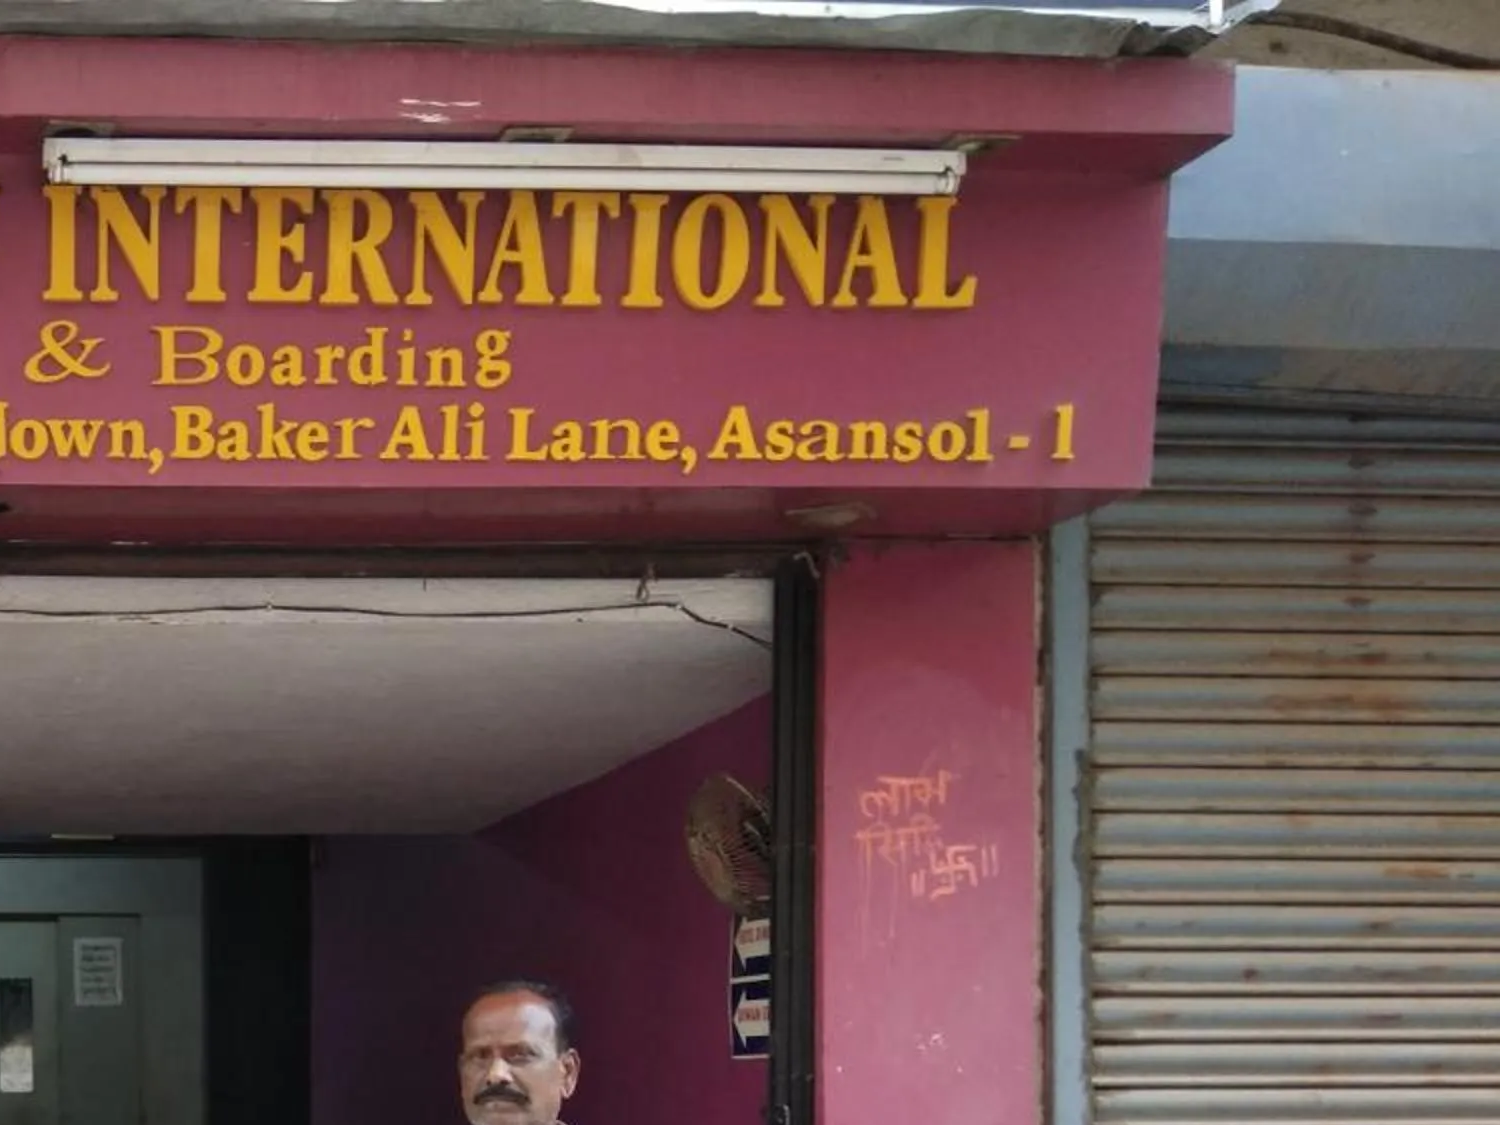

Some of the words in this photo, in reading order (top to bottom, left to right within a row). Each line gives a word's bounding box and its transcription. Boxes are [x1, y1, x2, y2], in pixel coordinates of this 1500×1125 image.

[41, 183, 977, 312] INTERNATIONAL
[24, 319, 110, 384] &
[154, 324, 513, 390] Boarding
[169, 401, 376, 463] Baker
[378, 401, 489, 463] Ali
[505, 406, 698, 475] Lane,
[706, 404, 994, 463] Asansol
